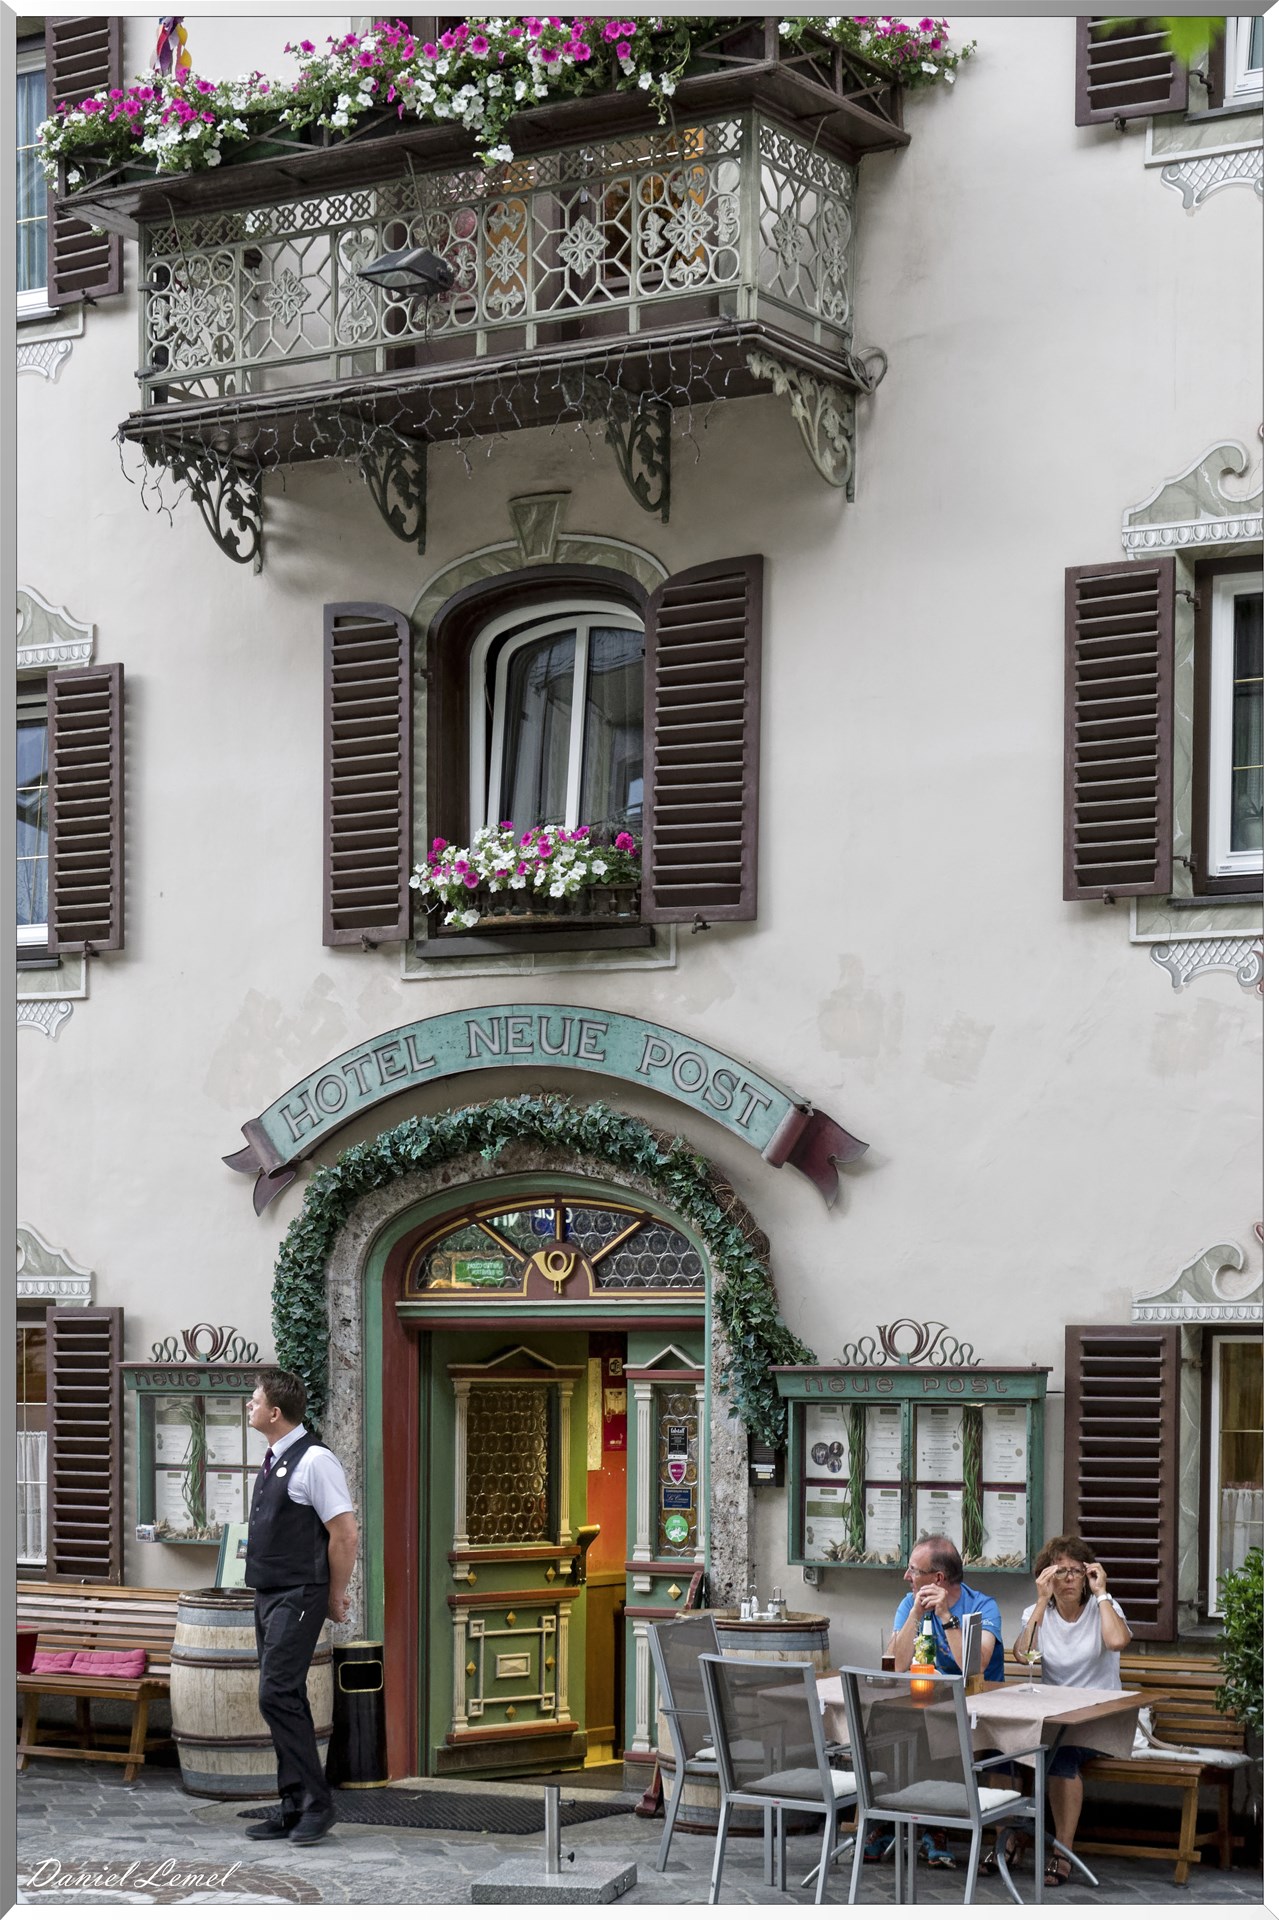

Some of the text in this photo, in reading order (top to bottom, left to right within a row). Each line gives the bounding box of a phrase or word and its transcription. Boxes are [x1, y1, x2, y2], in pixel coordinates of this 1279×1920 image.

[279, 1015, 773, 1143] HOTEL NEUE POST
[135, 1371, 256, 1388] neue pos
[805, 1376, 1008, 1394] neue post
